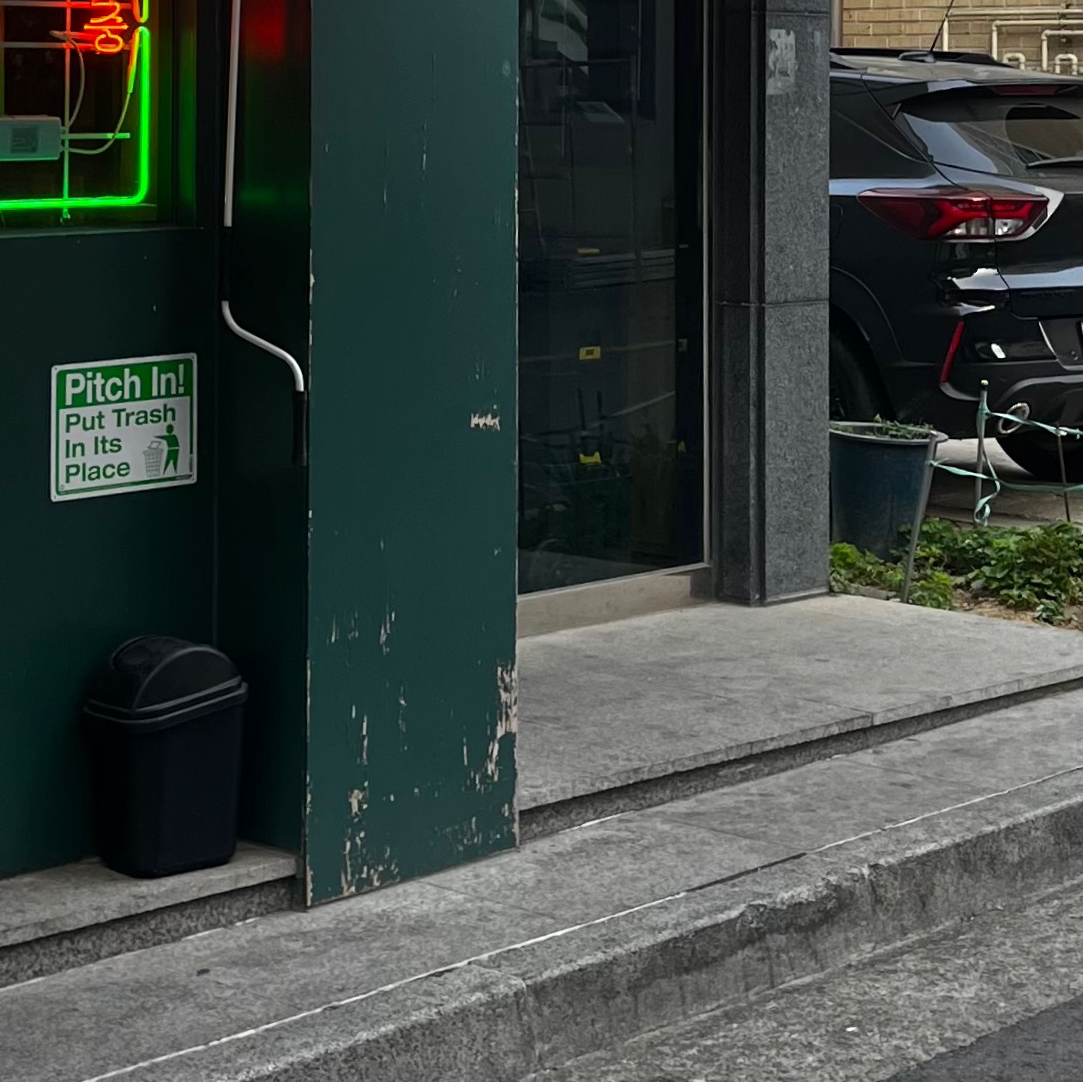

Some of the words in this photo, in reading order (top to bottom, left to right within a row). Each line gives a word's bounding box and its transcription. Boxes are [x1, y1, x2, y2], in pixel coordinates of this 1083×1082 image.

[65, 367, 141, 406] Pitch
[151, 364, 185, 396] In!
[65, 411, 105, 433] Put
[112, 403, 176, 427] Trash
[65, 439, 85, 458] In
[94, 435, 122, 455] Its
[65, 461, 130, 484] Place
